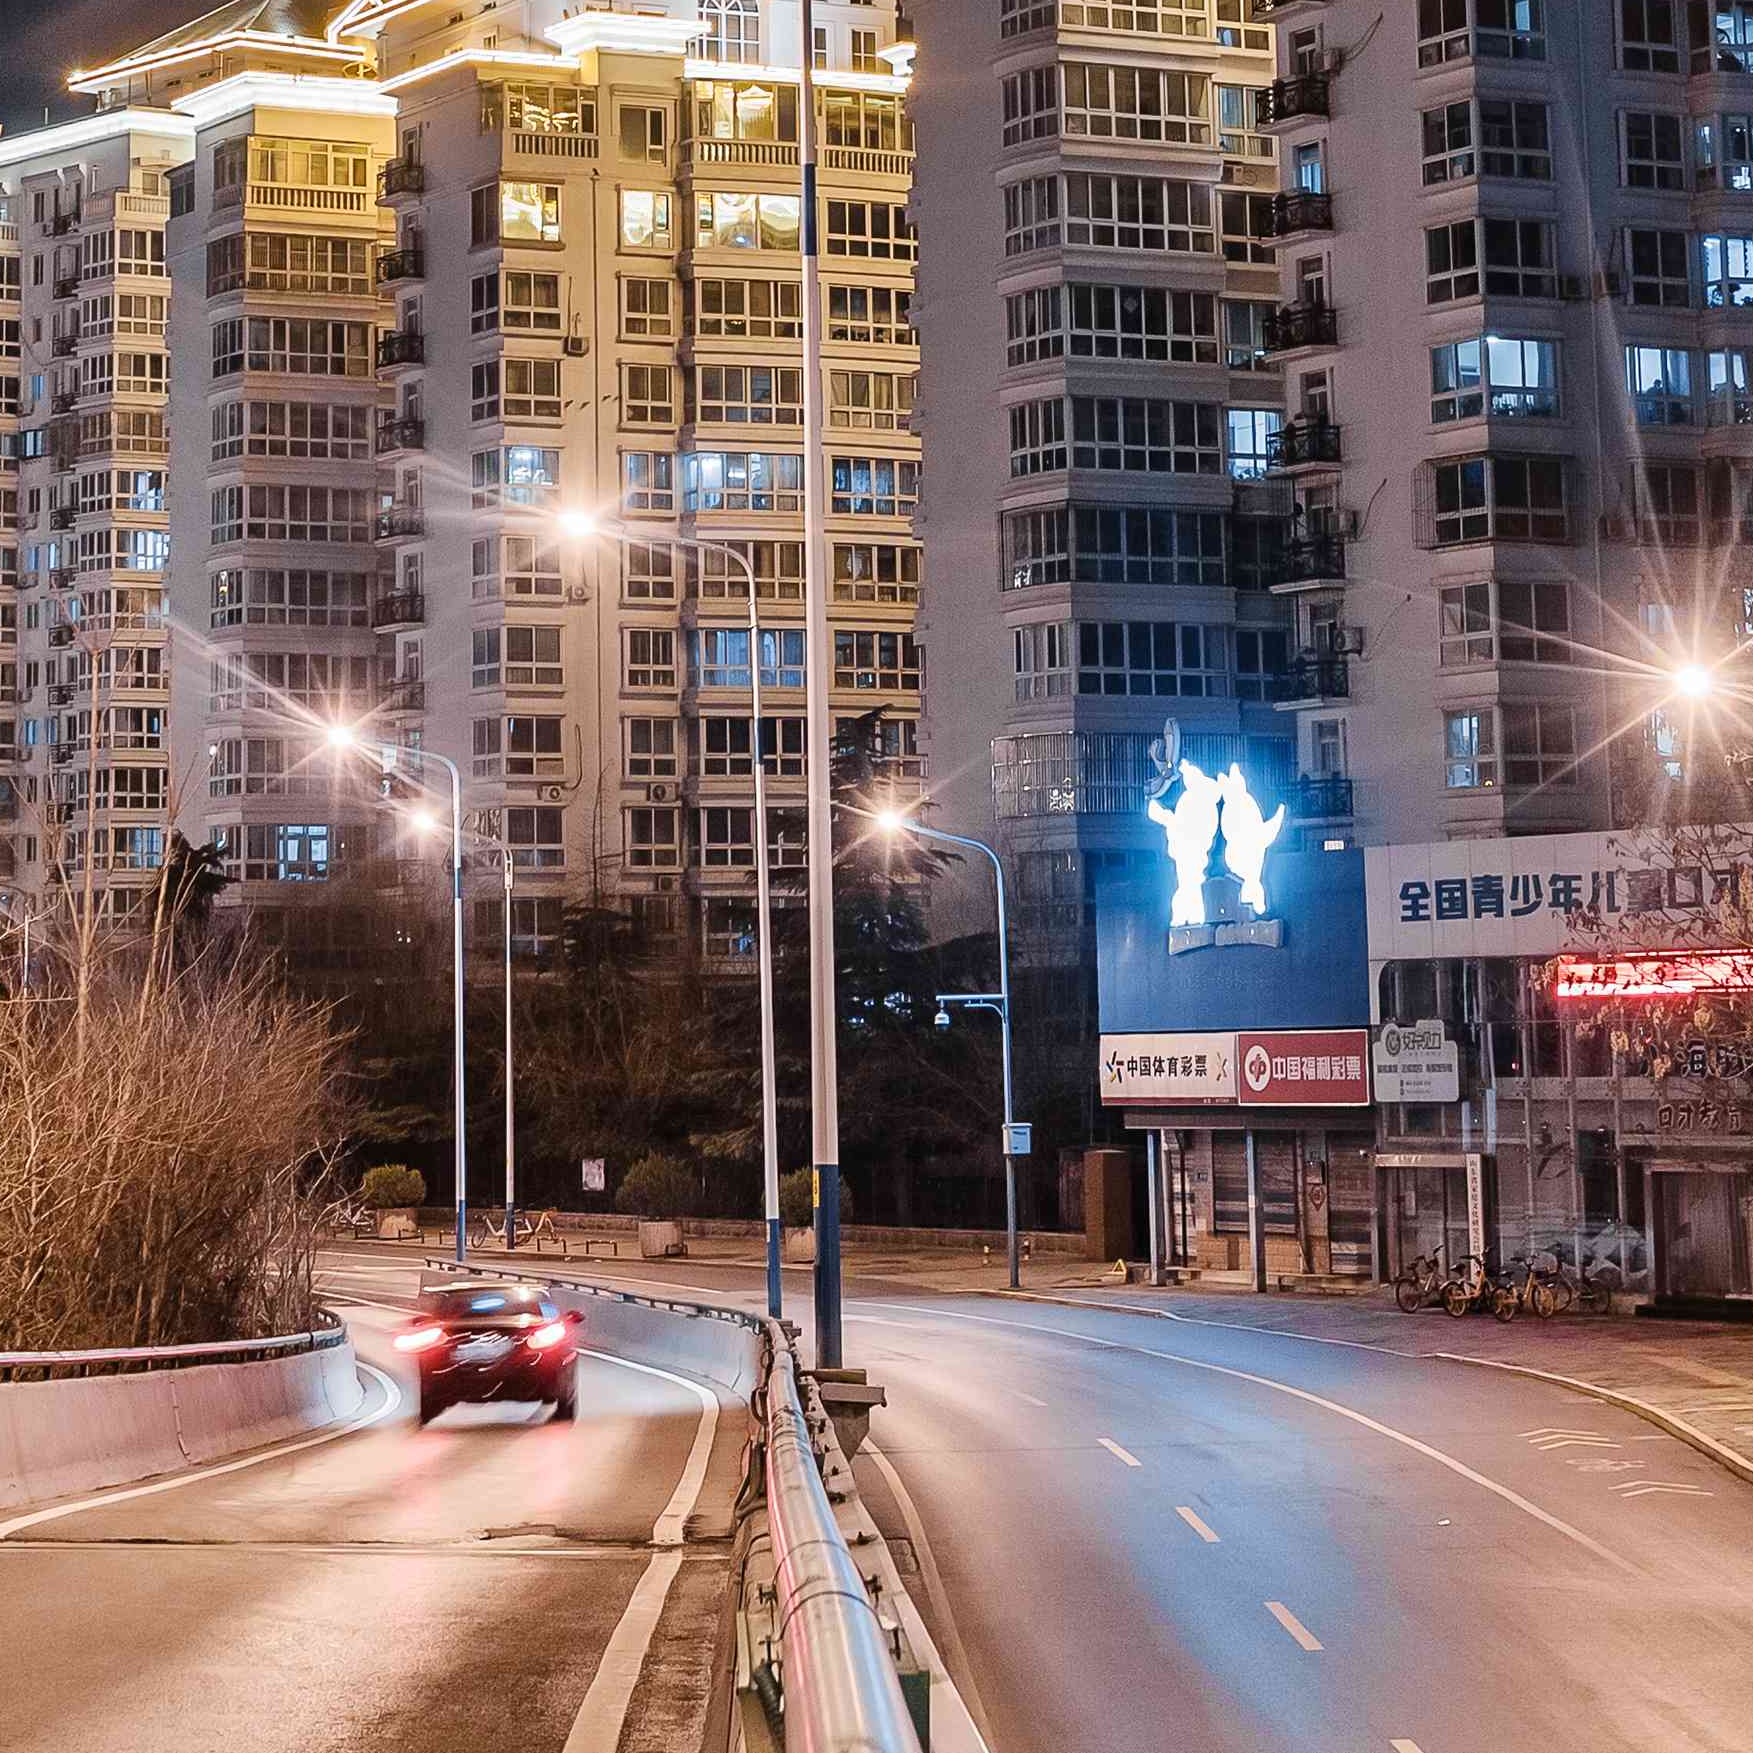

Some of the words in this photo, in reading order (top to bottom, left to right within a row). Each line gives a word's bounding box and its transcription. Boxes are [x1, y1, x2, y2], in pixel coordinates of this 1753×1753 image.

[1126, 1054, 1208, 1078] 中国体育彩票
[1272, 1055, 1361, 1081] 中国福利彩票
[1657, 1098, 1742, 1129] 口才教育
